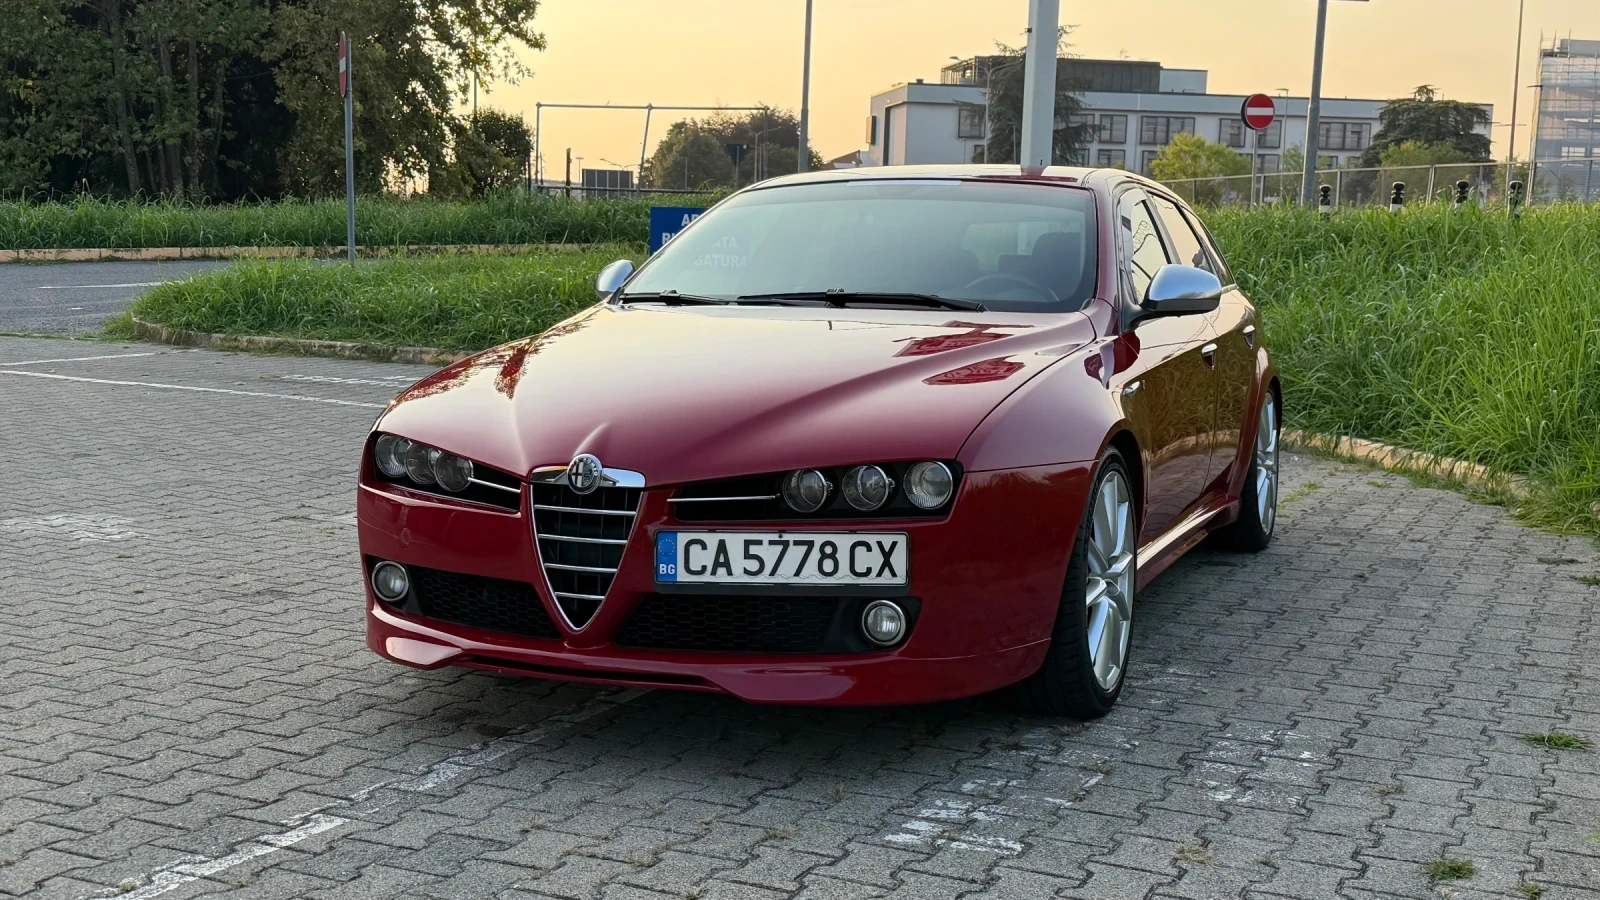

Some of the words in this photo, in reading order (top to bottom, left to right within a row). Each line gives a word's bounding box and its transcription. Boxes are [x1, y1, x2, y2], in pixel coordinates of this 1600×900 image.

[659, 563, 676, 575] BG
[683, 538, 734, 576] CA
[743, 539, 839, 577] 5778
[848, 540, 899, 578] CX
